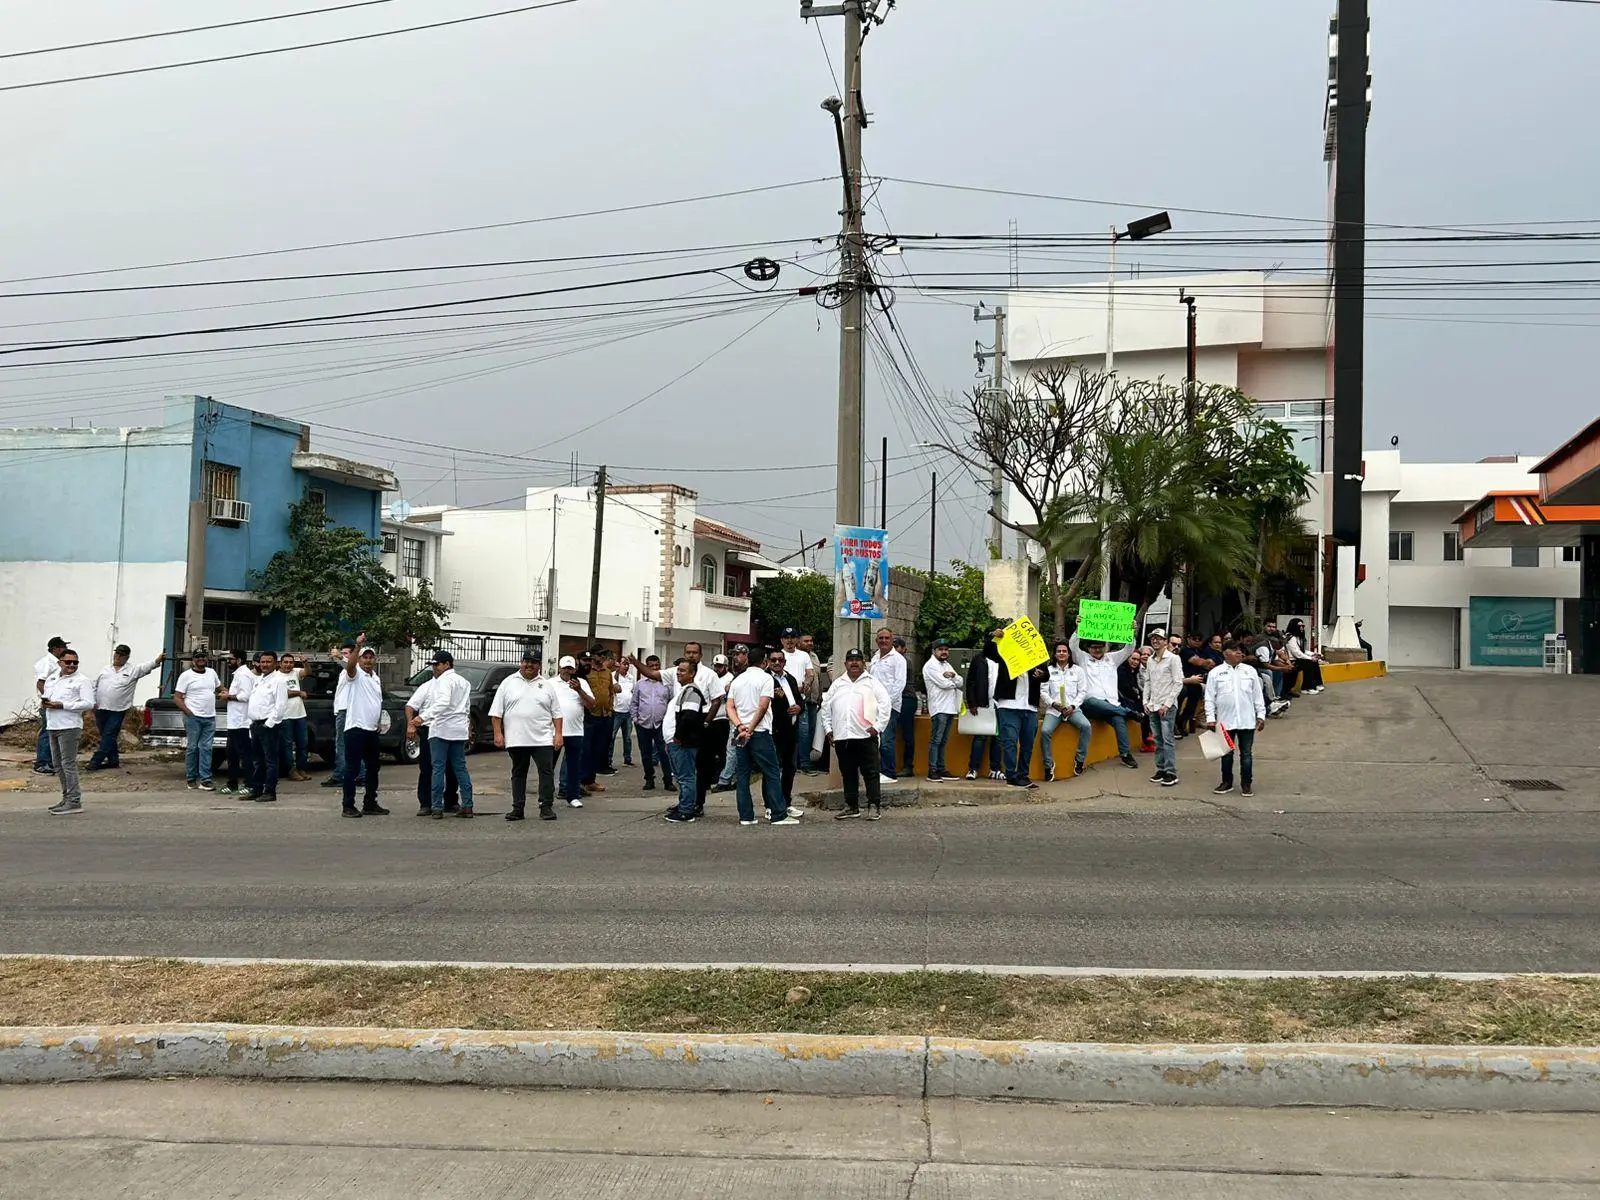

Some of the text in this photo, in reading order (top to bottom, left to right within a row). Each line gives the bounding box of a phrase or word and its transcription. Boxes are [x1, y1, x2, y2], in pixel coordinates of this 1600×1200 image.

[840, 538, 882, 549] PARA TODOS
[841, 548, 881, 558] LOS GUSTOS
